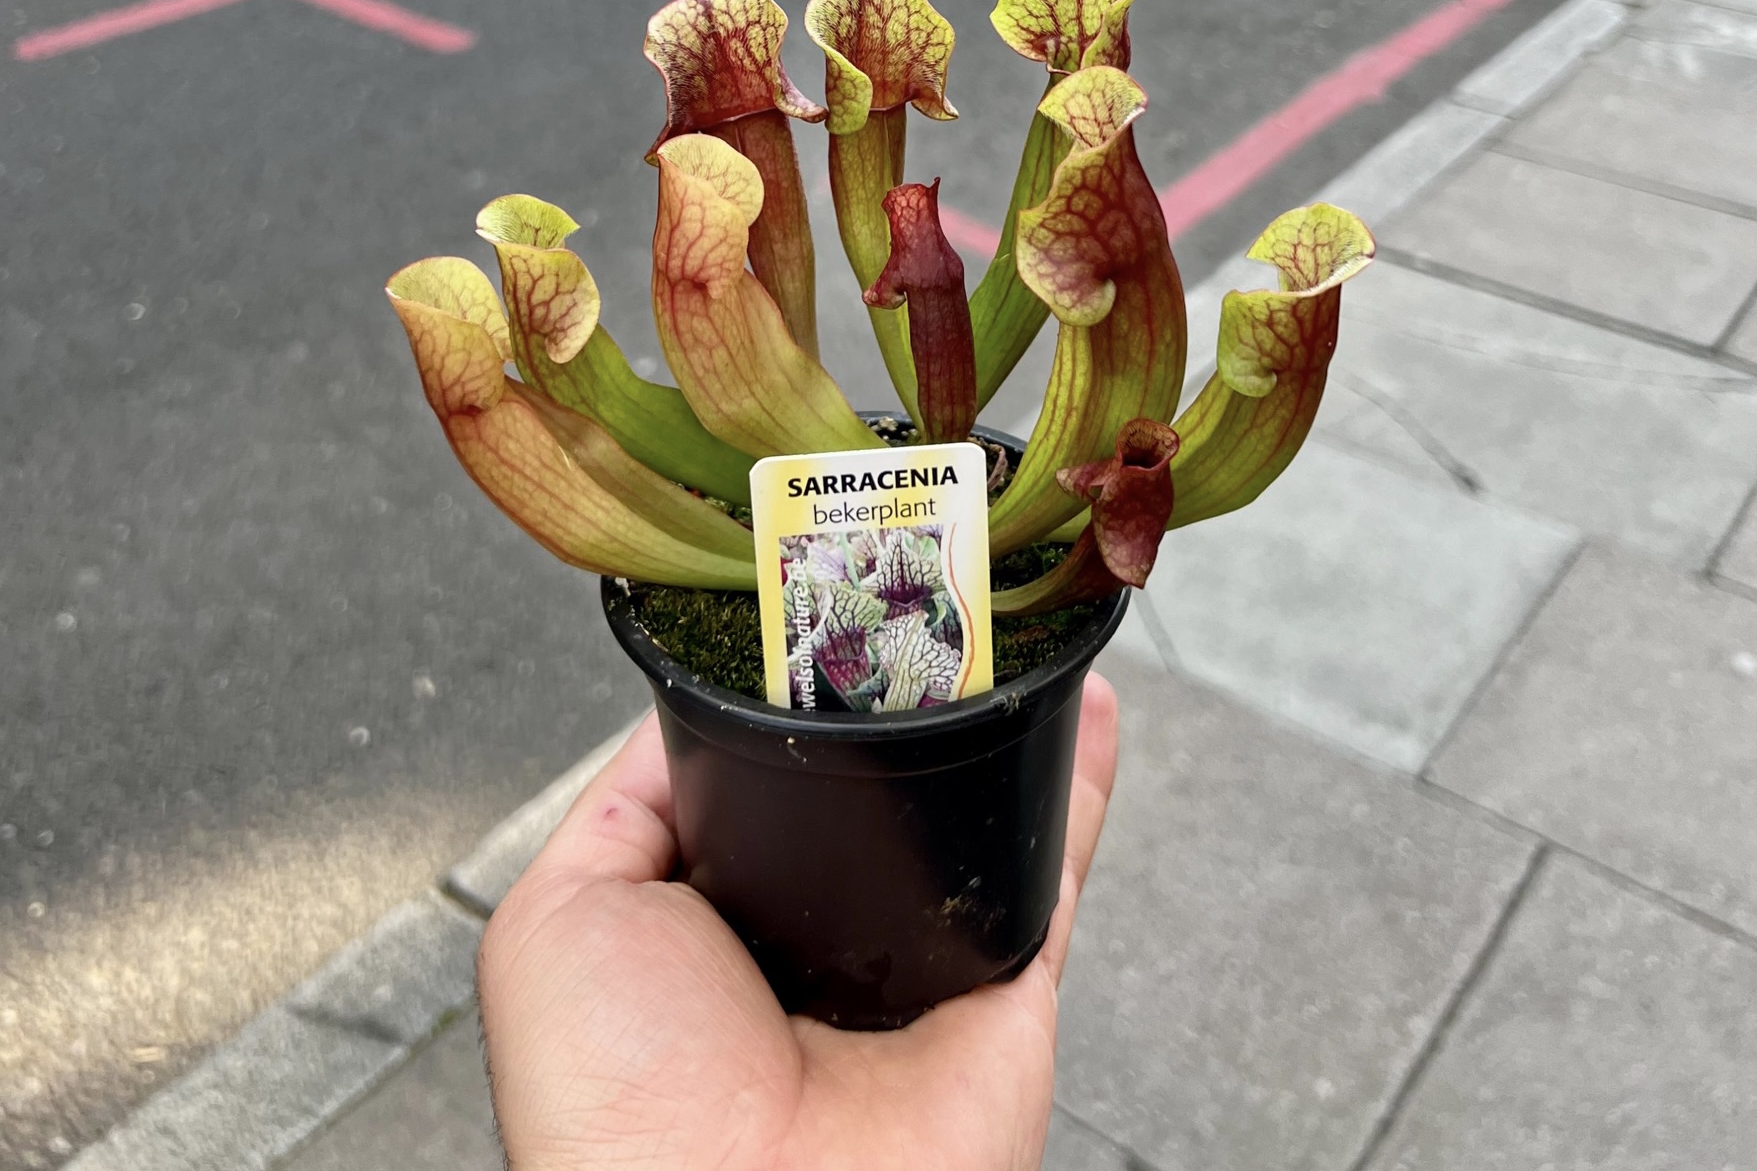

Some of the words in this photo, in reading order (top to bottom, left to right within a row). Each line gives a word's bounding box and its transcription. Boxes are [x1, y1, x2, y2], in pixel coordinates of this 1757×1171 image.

[787, 465, 959, 497] SARRACENIA
[813, 497, 937, 525] bekerplant
[793, 558, 816, 712] welsofnature.be
